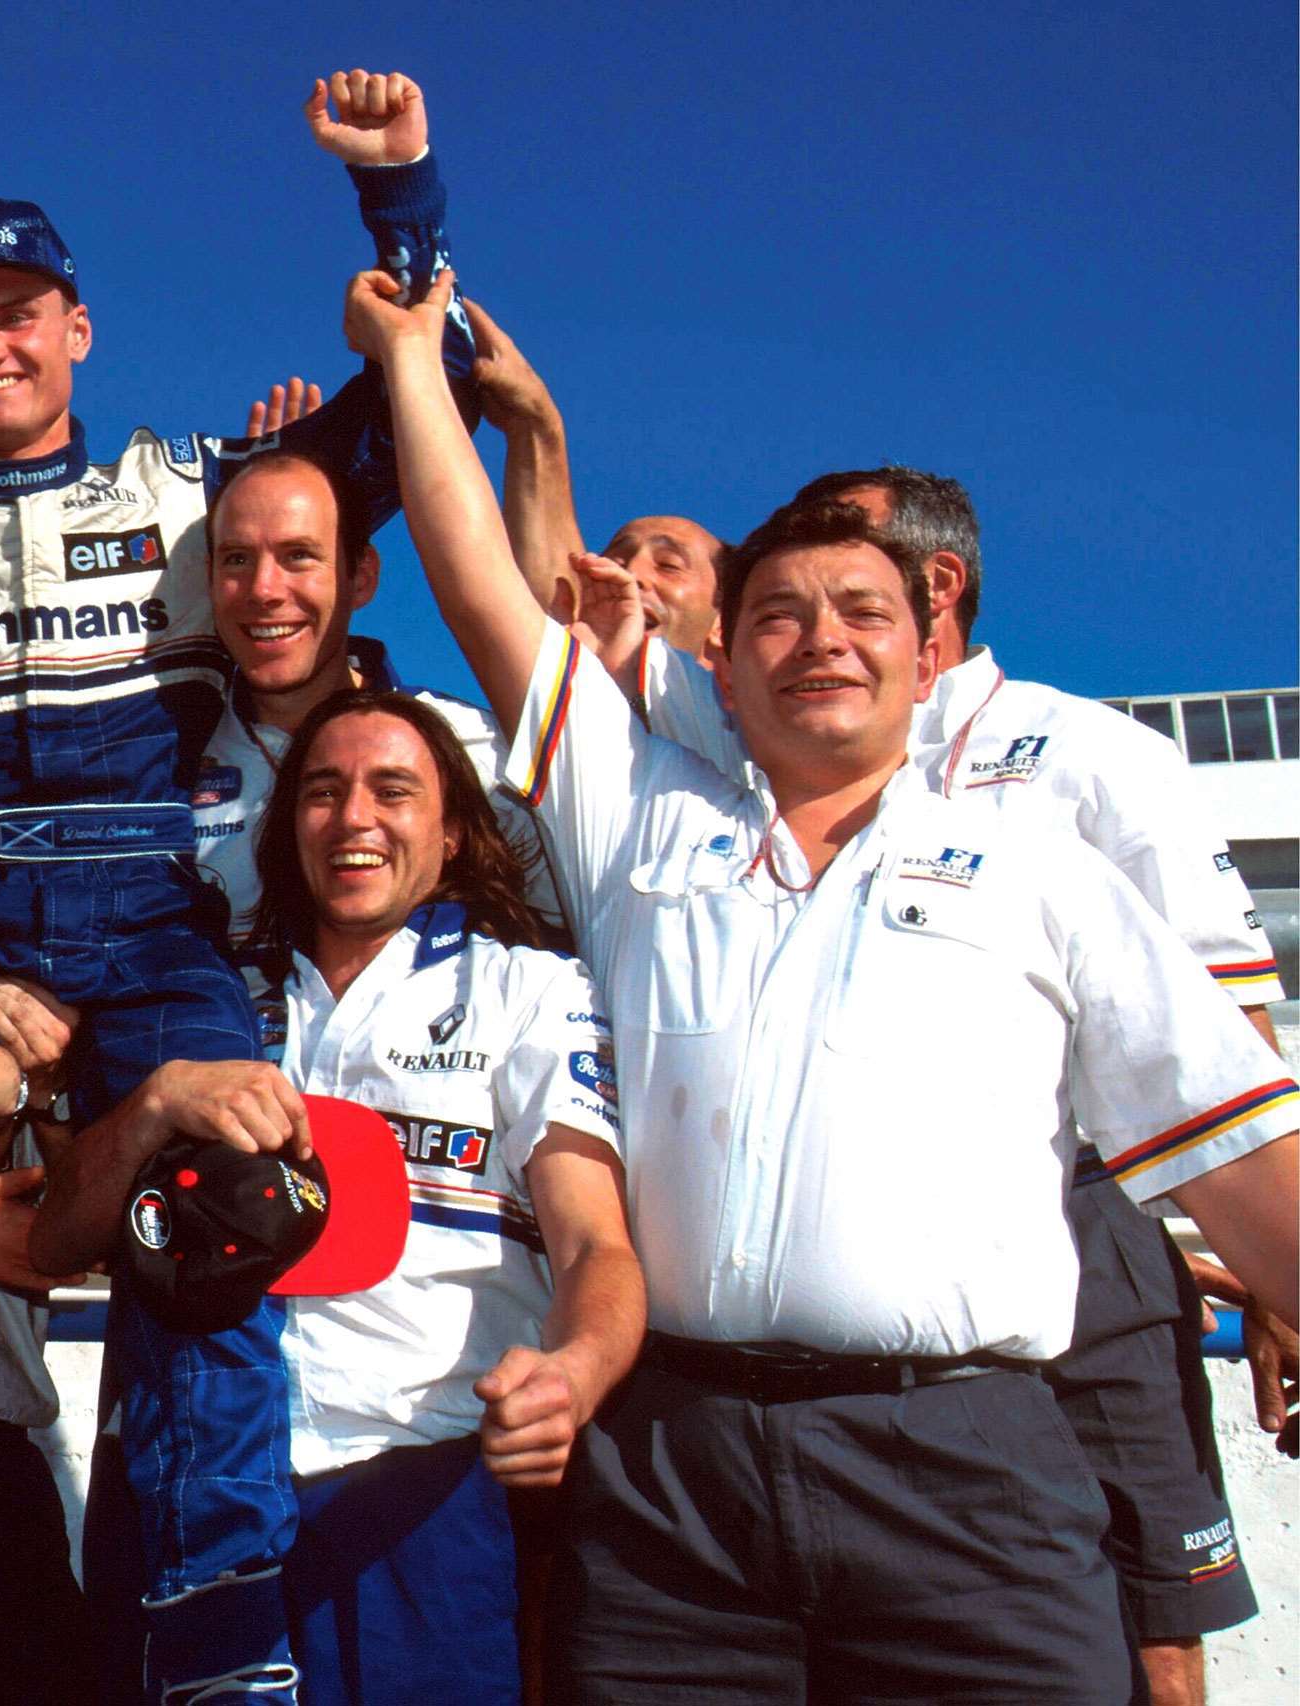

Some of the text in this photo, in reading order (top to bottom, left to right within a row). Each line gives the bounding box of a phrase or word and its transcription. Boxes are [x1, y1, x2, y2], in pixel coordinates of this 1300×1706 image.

[70, 541, 125, 572] elf
[1002, 735, 1049, 761] F1
[971, 757, 1040, 774] RENAULT
[992, 767, 1033, 778] sport
[902, 857, 981, 876] RENAULT
[938, 847, 984, 869] F1
[931, 869, 974, 882] sport
[387, 1048, 491, 1074] RENAULT
